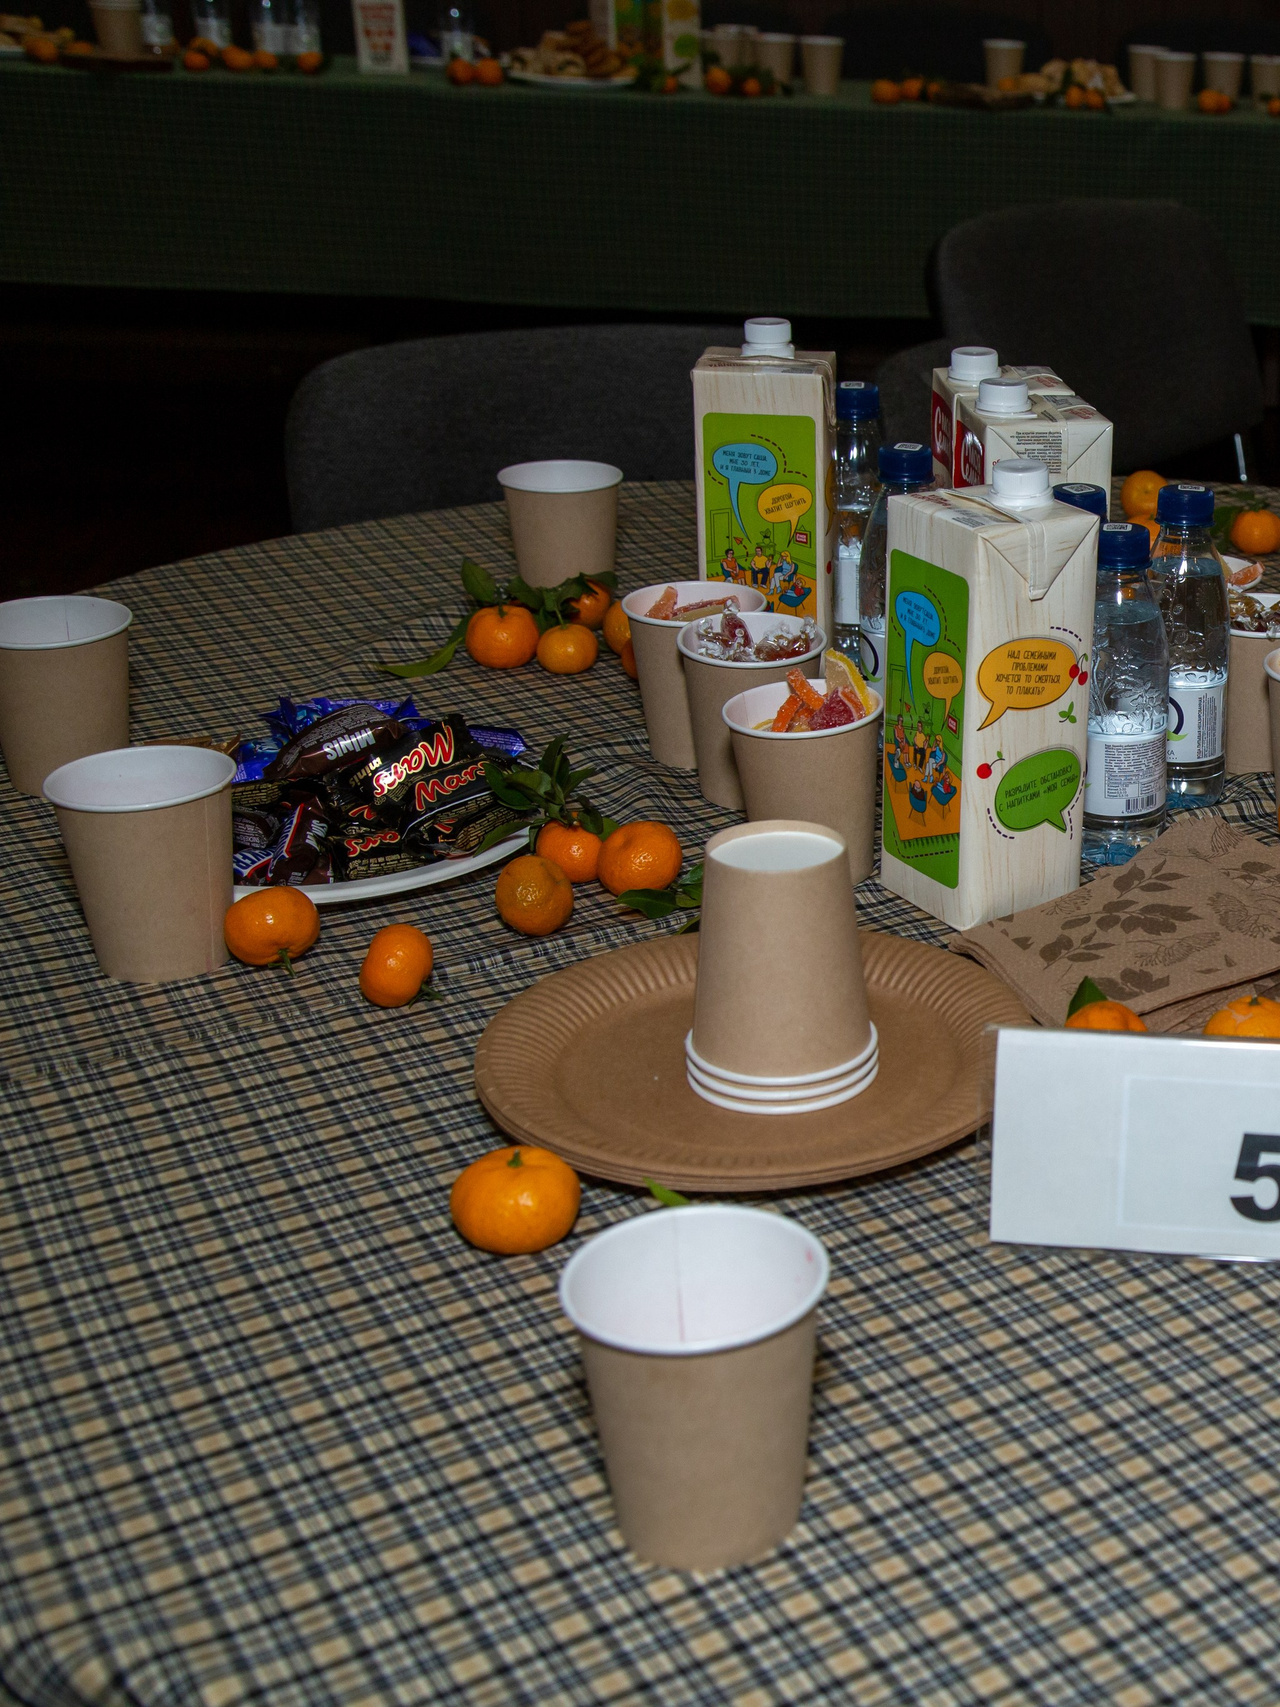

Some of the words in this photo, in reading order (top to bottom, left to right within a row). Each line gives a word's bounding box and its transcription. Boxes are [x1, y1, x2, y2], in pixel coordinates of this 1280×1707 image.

[764, 505, 783, 514] ХВАТИТ
[785, 498, 806, 509] ШУТИТЬ
[1007, 650, 1020, 659] НАД
[1023, 650, 1056, 660] СЕМЕЙНЫМИ
[1012, 662, 1048, 671] ПРОБЛЕМАМИ
[995, 674, 1021, 683] ХОЧЕТСЯ
[1025, 675, 1032, 683] ТО
[1006, 686, 1014, 694] ТО
[1016, 686, 1045, 696] ПЛАКАТЬ?
[322, 727, 376, 761] MINIS
[373, 725, 455, 797] Mars
[1004, 779, 1037, 798] РАЗРЯДИТЕ
[1040, 763, 1072, 785] ОБСТАНОВКУ
[999, 803, 1003, 812] С
[1006, 790, 1040, 809] НАПИТКАМИ
